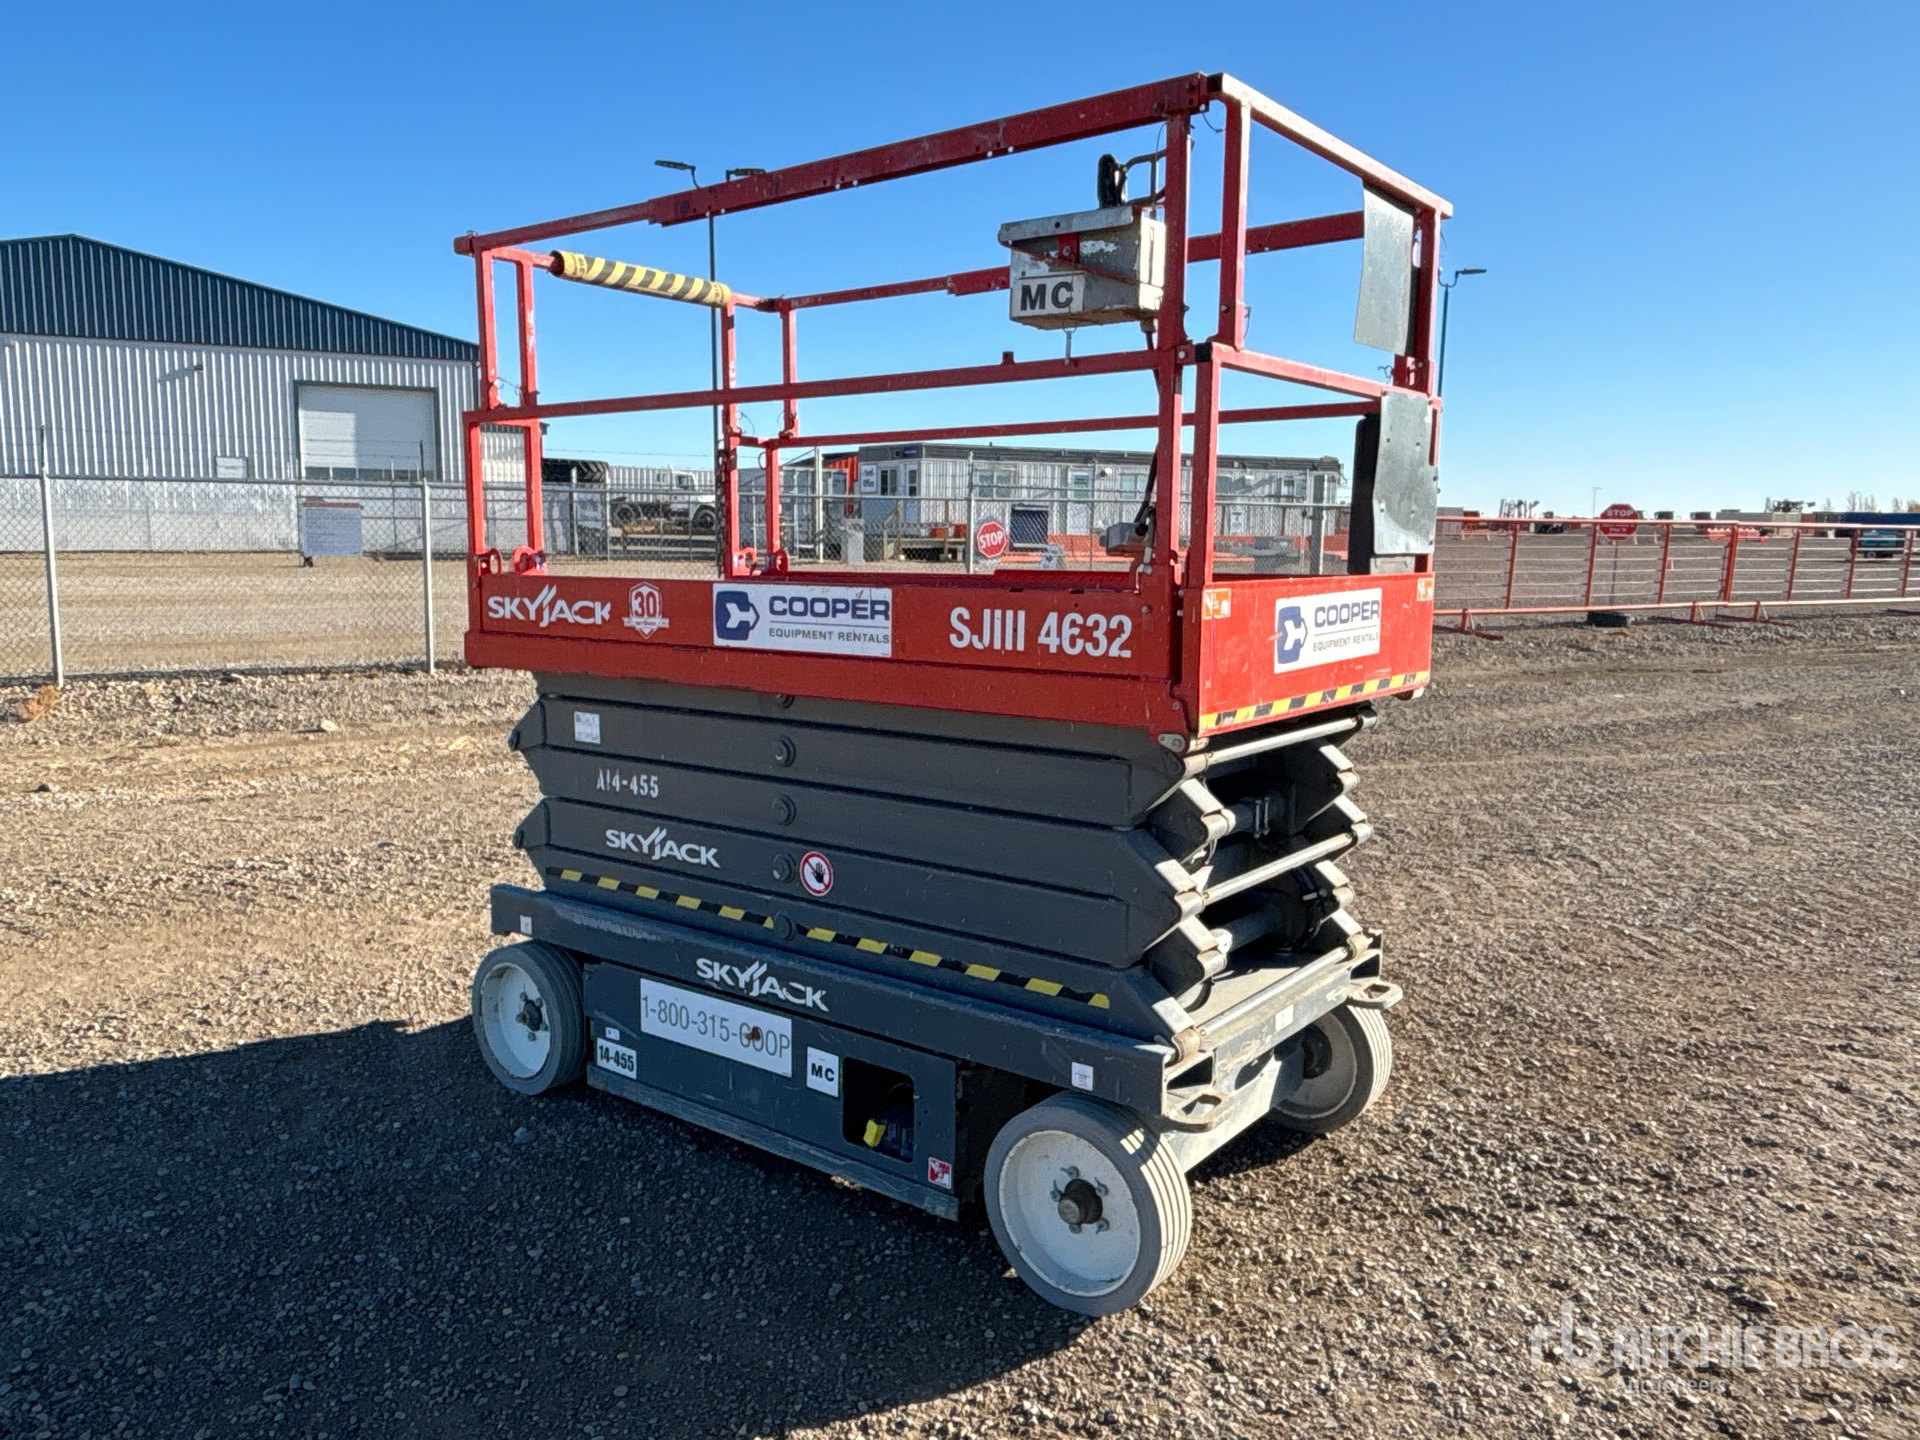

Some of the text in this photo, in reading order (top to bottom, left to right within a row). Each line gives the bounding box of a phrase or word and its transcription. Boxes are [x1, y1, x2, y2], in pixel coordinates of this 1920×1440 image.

[1020, 281, 1073, 311] MC
[1606, 509, 1634, 517] STOP
[979, 530, 1003, 549] STOP
[488, 584, 611, 627] SKYJACK
[634, 591, 657, 618] 30
[769, 595, 890, 621] COOPER
[1314, 600, 1380, 628] COOPER
[769, 628, 890, 644] EQUIPMENT RENTALS
[949, 606, 1132, 658] SJIII 4632
[1312, 632, 1379, 652] EQUIPMENT RENTALS
[596, 768, 660, 798] A14-455
[605, 826, 720, 868] SKYJACK
[696, 958, 829, 1012] SKYJACK
[599, 1045, 634, 1072] 14-455
[811, 1062, 835, 1082] MC
